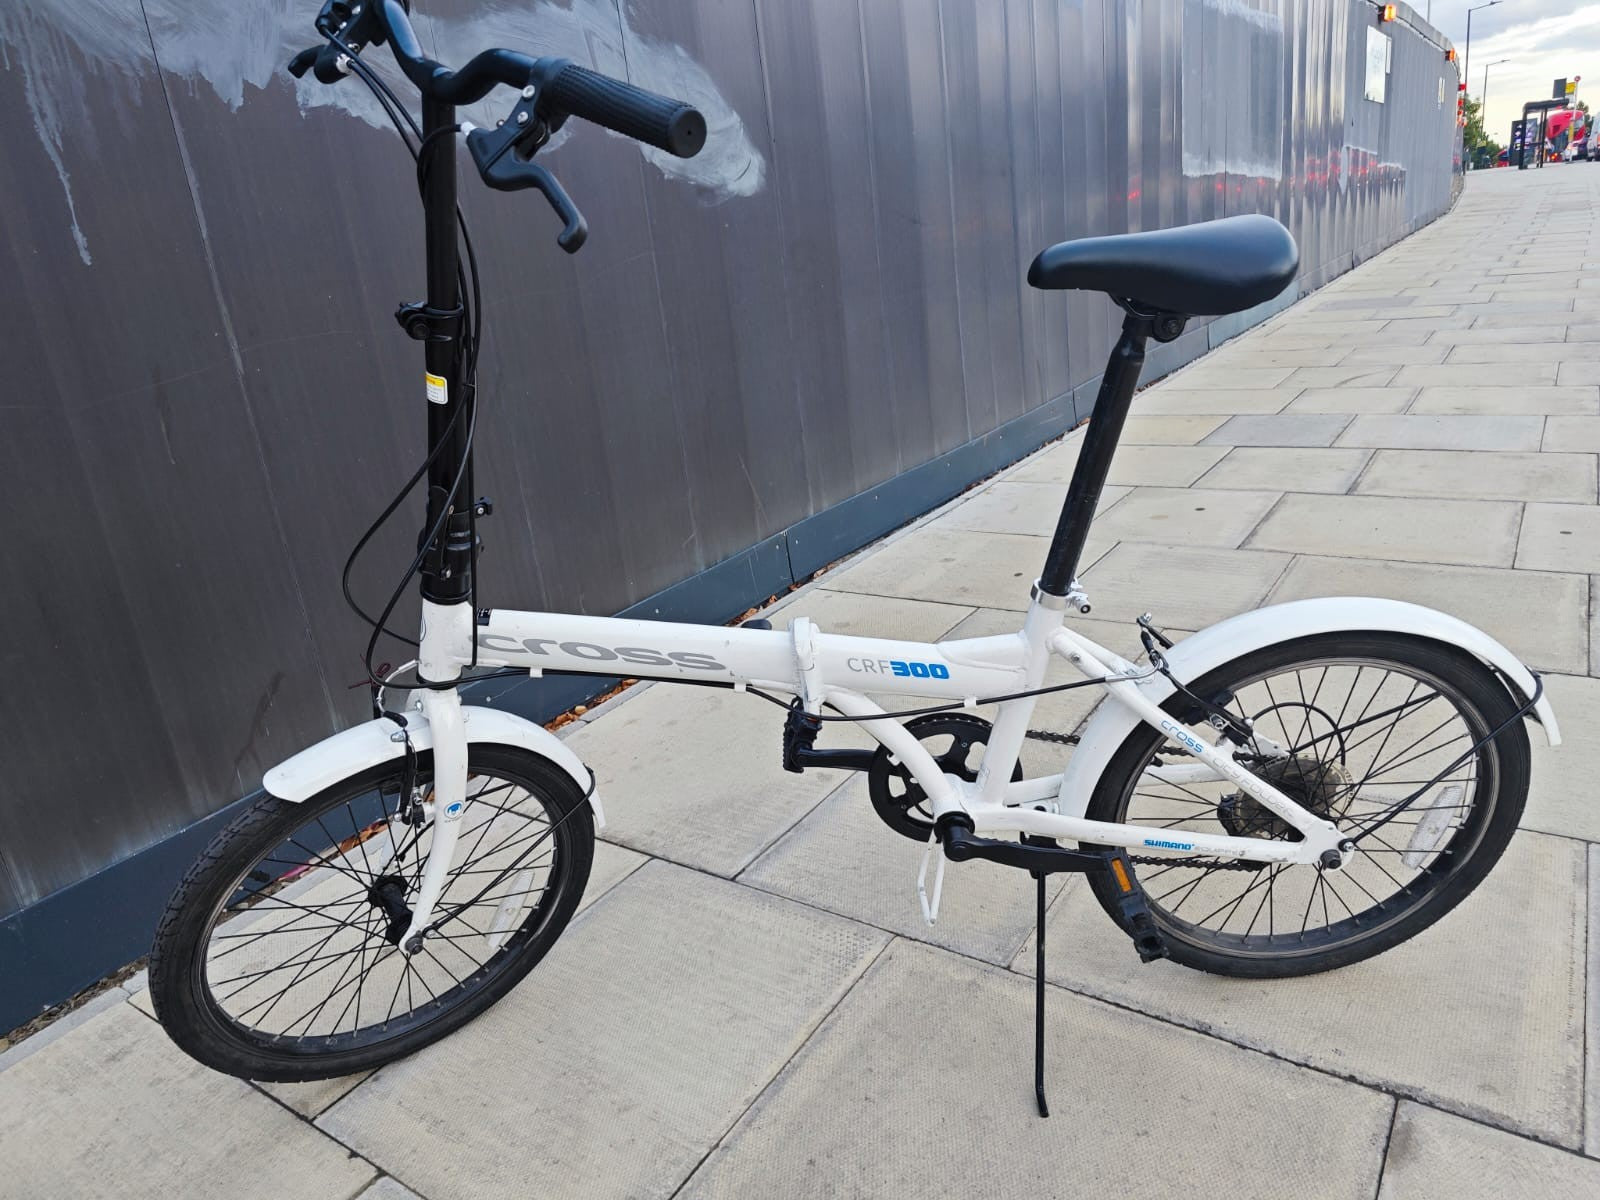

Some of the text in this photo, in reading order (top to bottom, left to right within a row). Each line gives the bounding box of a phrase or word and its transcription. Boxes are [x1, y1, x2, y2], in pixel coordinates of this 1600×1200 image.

[468, 633, 727, 671] cross
[847, 657, 950, 680] CRF300
[1160, 719, 1204, 753] cross
[1143, 839, 1192, 851] SHIMANO
